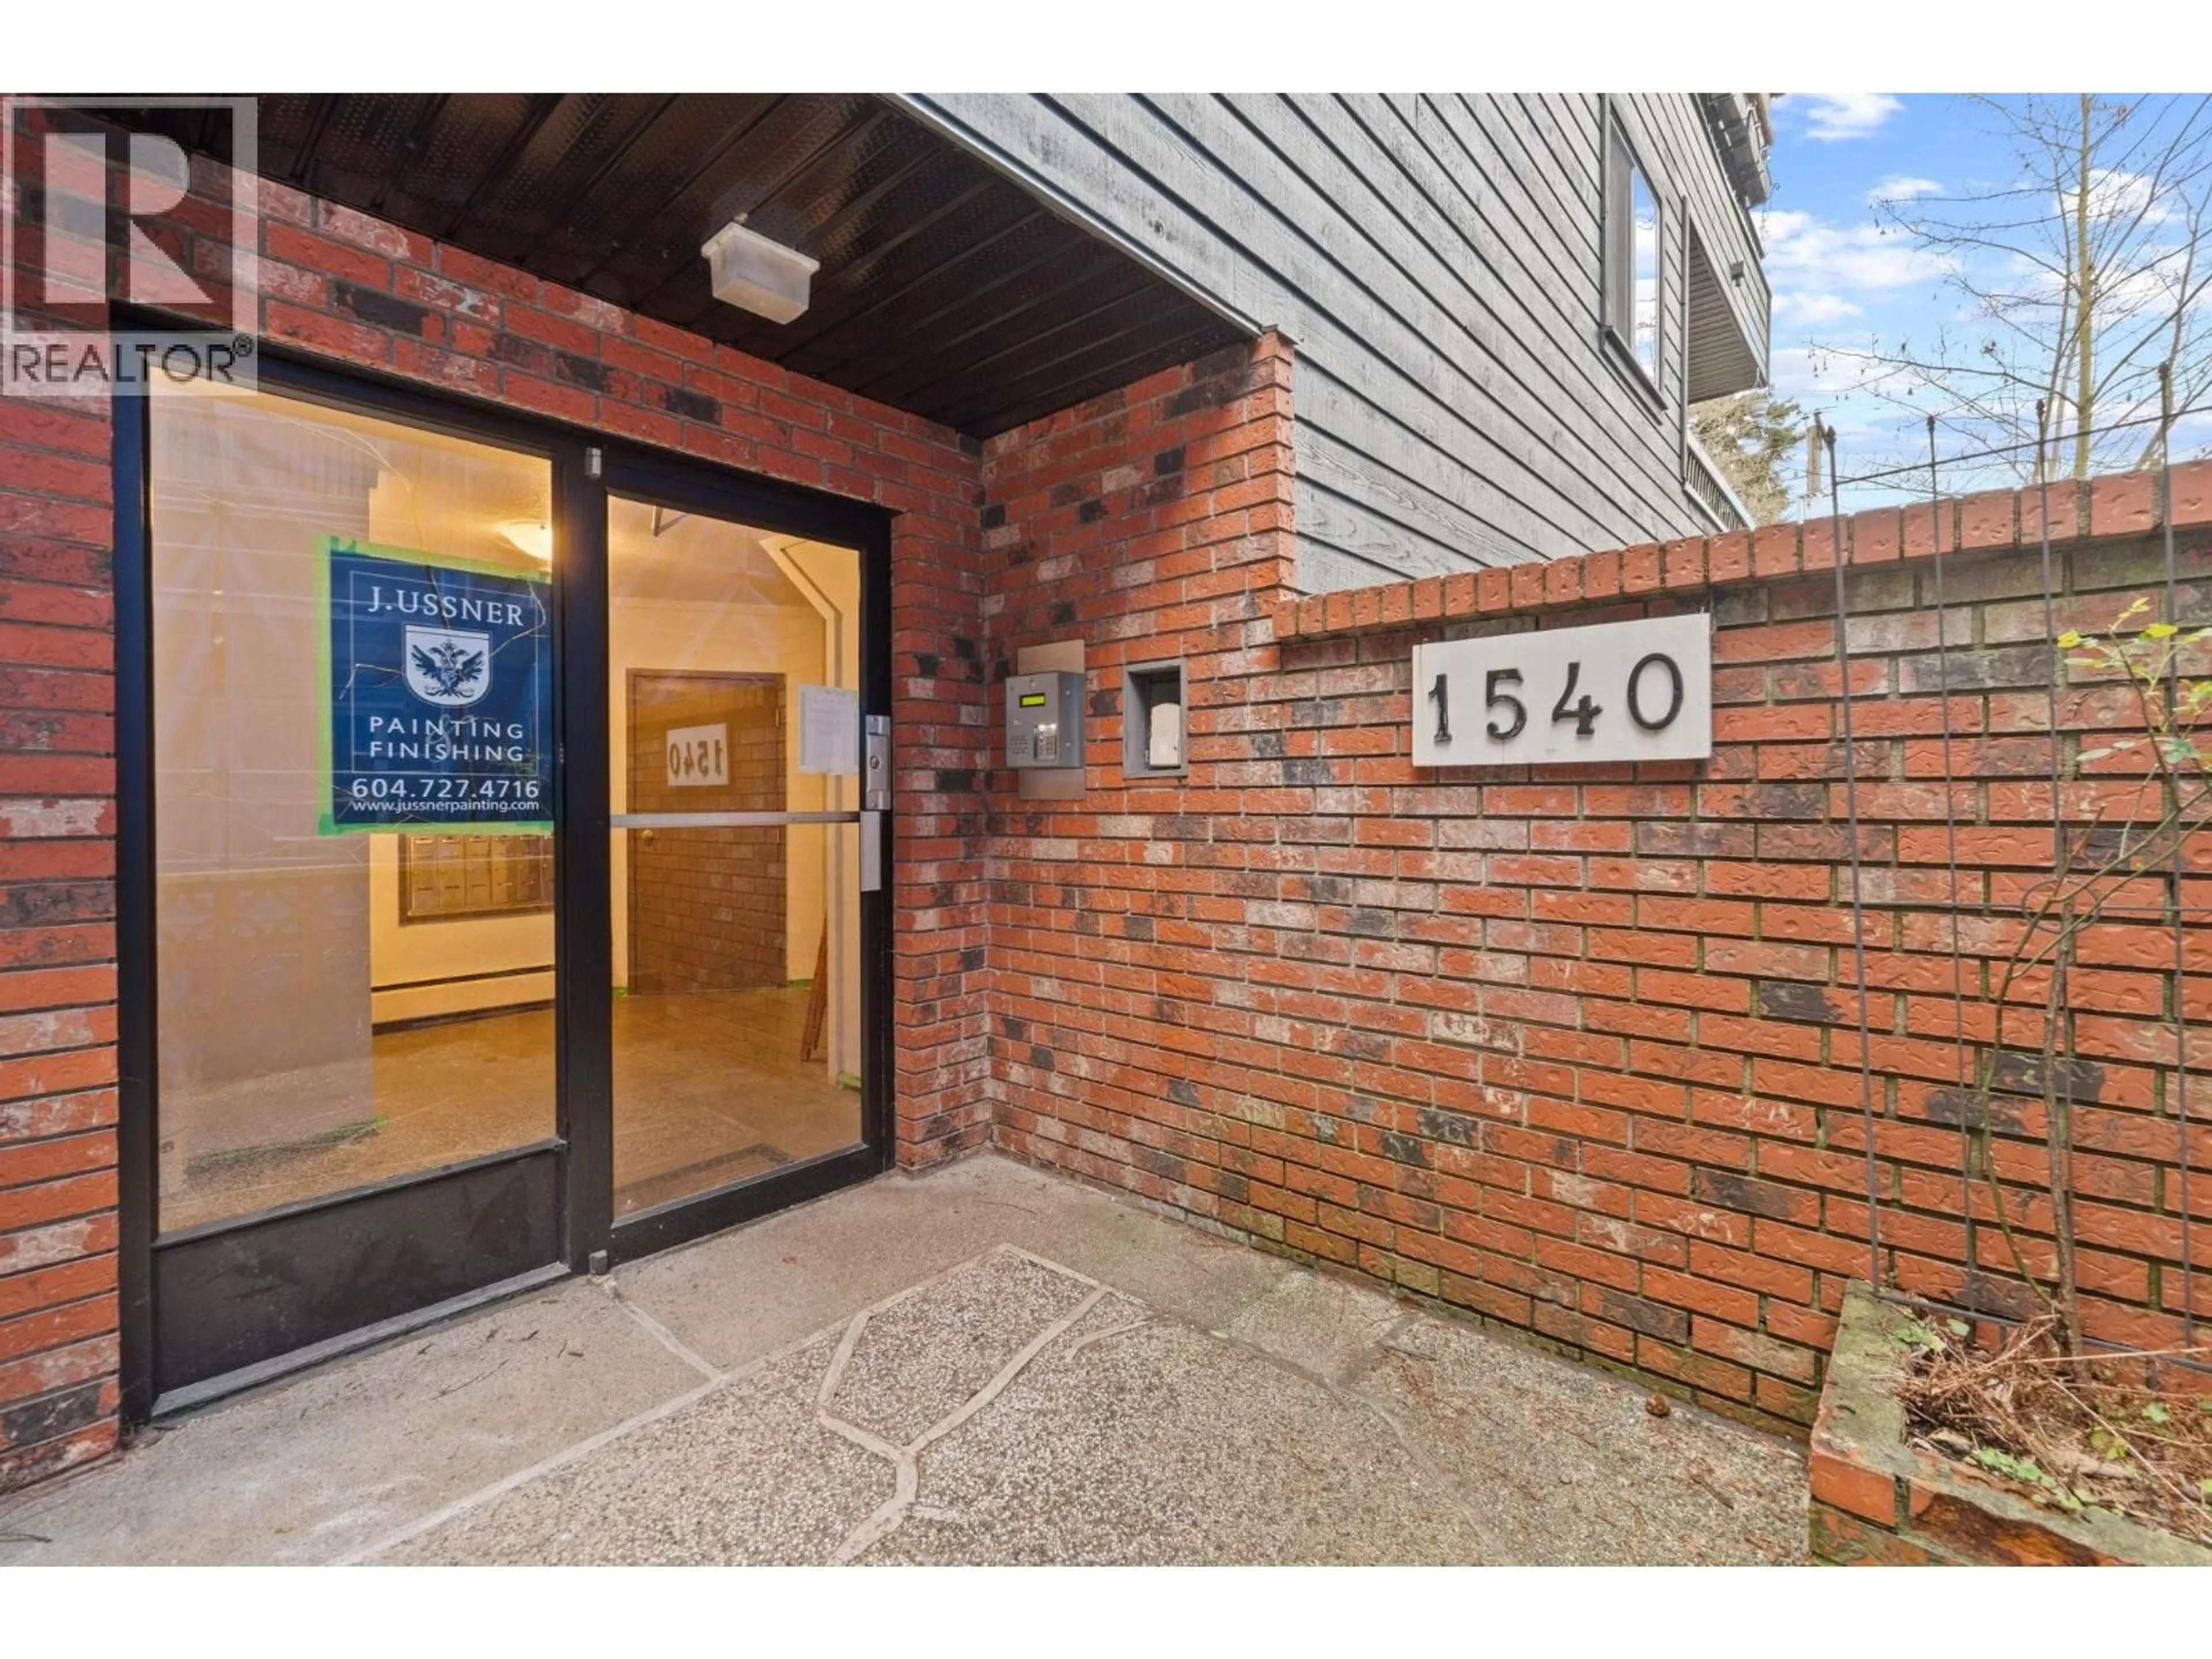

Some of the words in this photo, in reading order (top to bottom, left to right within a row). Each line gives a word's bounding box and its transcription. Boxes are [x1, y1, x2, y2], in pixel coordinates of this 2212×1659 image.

[1428, 652, 1684, 743] 1540
[370, 716, 523, 739] PAINTING
[370, 741, 523, 762] FINISHING
[351, 778, 539, 799] 604.727.4716
[353, 798, 540, 813] www.jussnerpainting.com
